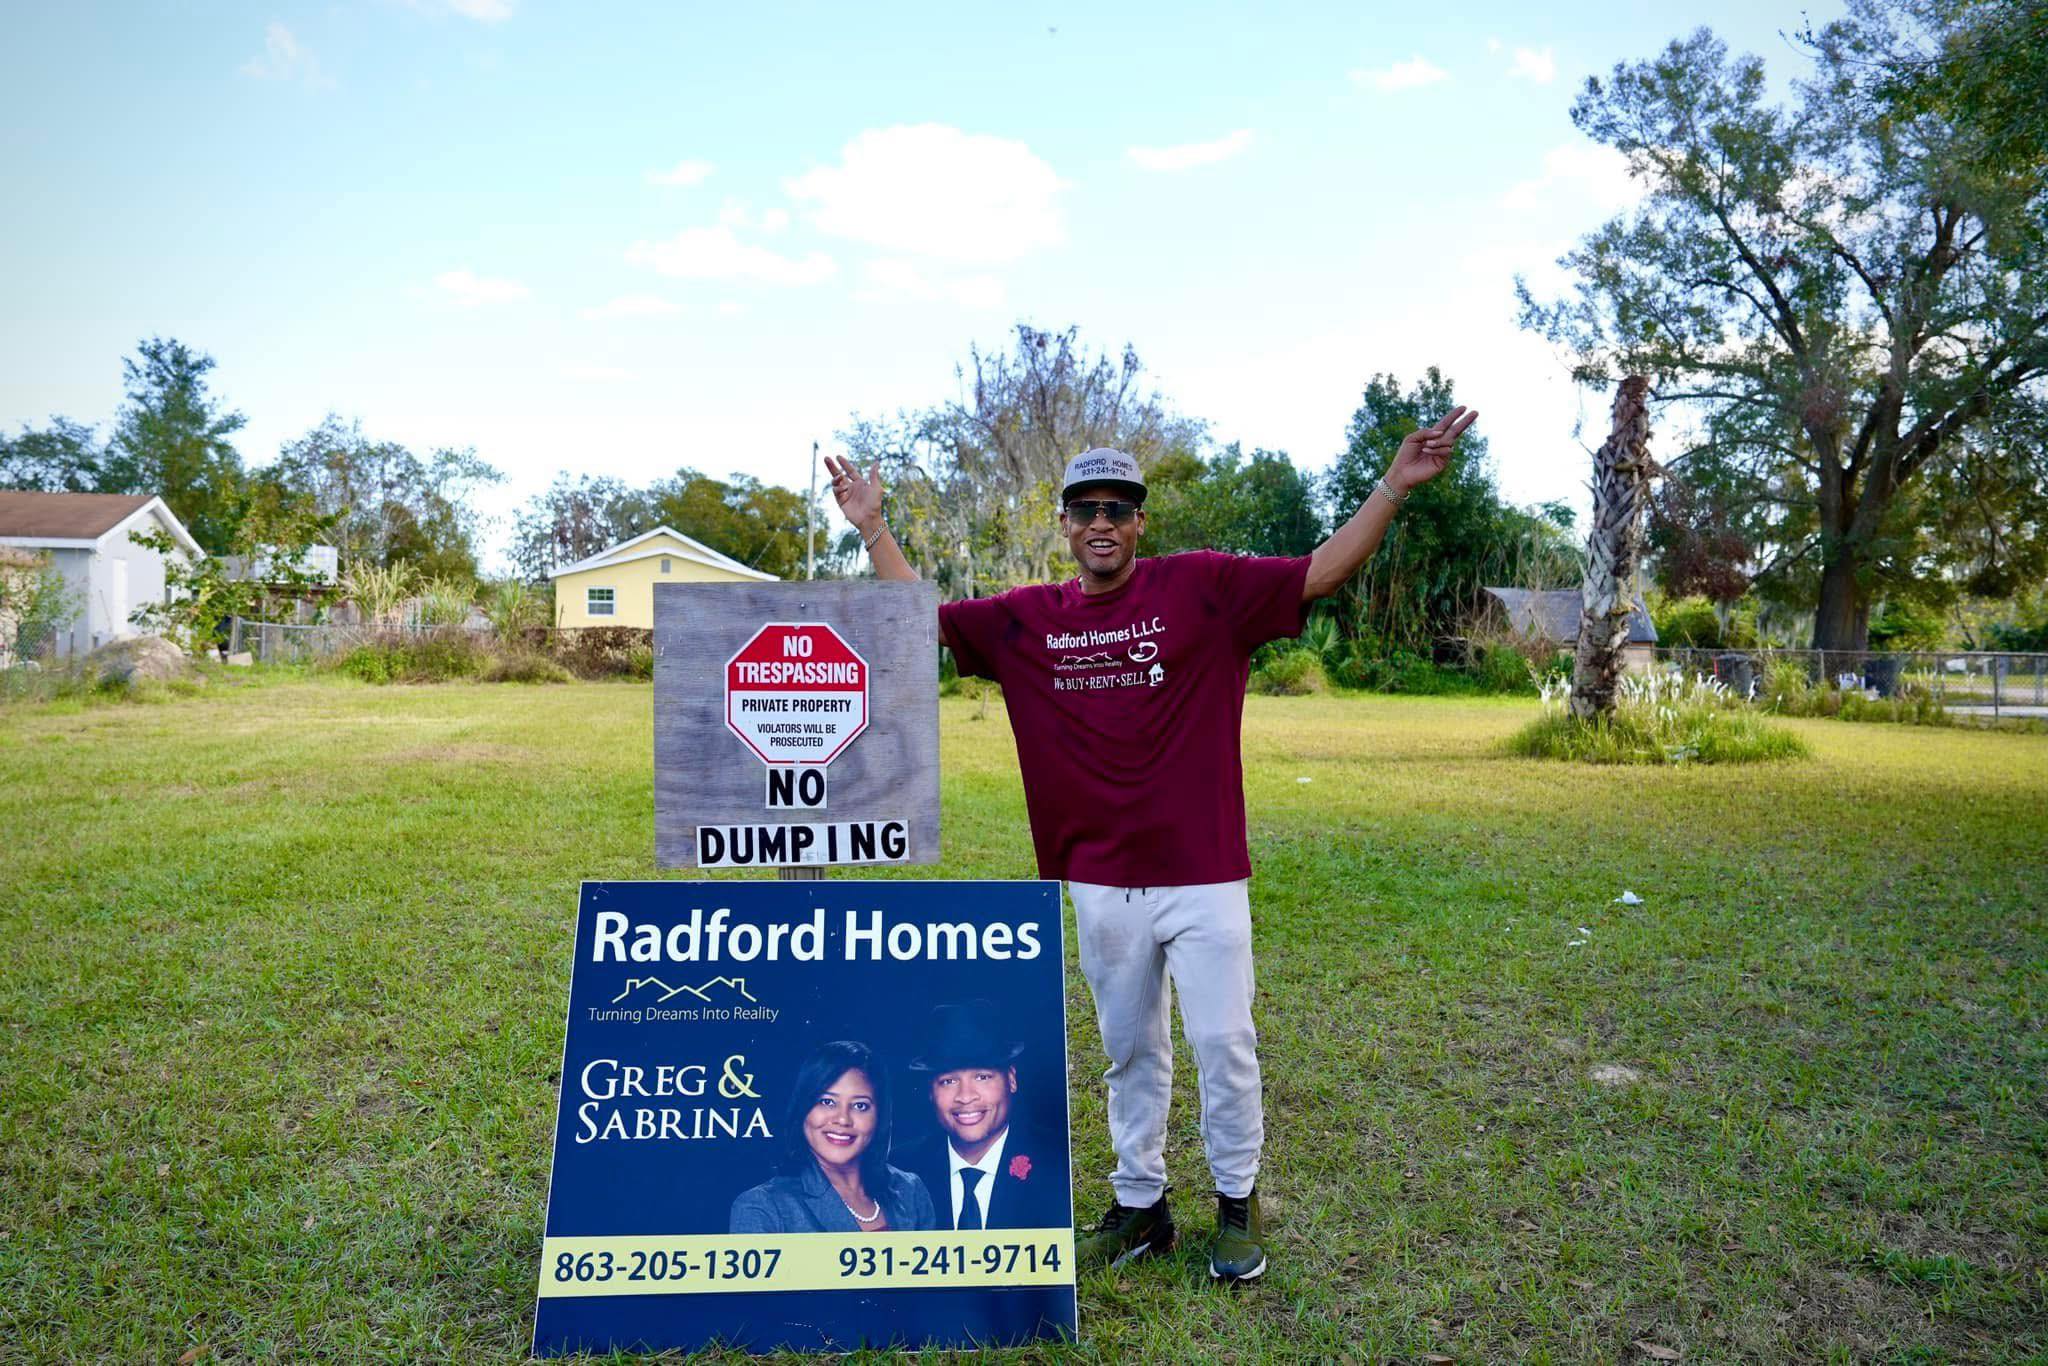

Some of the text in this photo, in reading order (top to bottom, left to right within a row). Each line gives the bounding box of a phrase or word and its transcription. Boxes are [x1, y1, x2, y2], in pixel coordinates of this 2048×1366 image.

[1074, 458, 1133, 472] RADFORD HOMES
[1081, 466, 1127, 477] 931-241-9714
[1046, 617, 1166, 649] Radford Homes L.L.C.
[783, 635, 813, 658] NO
[735, 661, 859, 685] TRESPASSING
[1054, 677, 1065, 690] We
[742, 698, 852, 713] PRIVATE PROPERTY
[757, 723, 837, 734] VIOLATORS WILL BE
[770, 736, 824, 747] PROSECUTED
[769, 768, 825, 807] NO
[700, 822, 906, 865] DUMPING
[592, 908, 1041, 962] Radford Homes
[588, 1005, 780, 1025] Turning Dreams Into Reality
[581, 1054, 761, 1100] GREG &
[575, 1100, 774, 1144] SABRINA
[554, 1249, 782, 1282] 863-205-1307
[839, 1243, 1062, 1277] 931-241-9714
